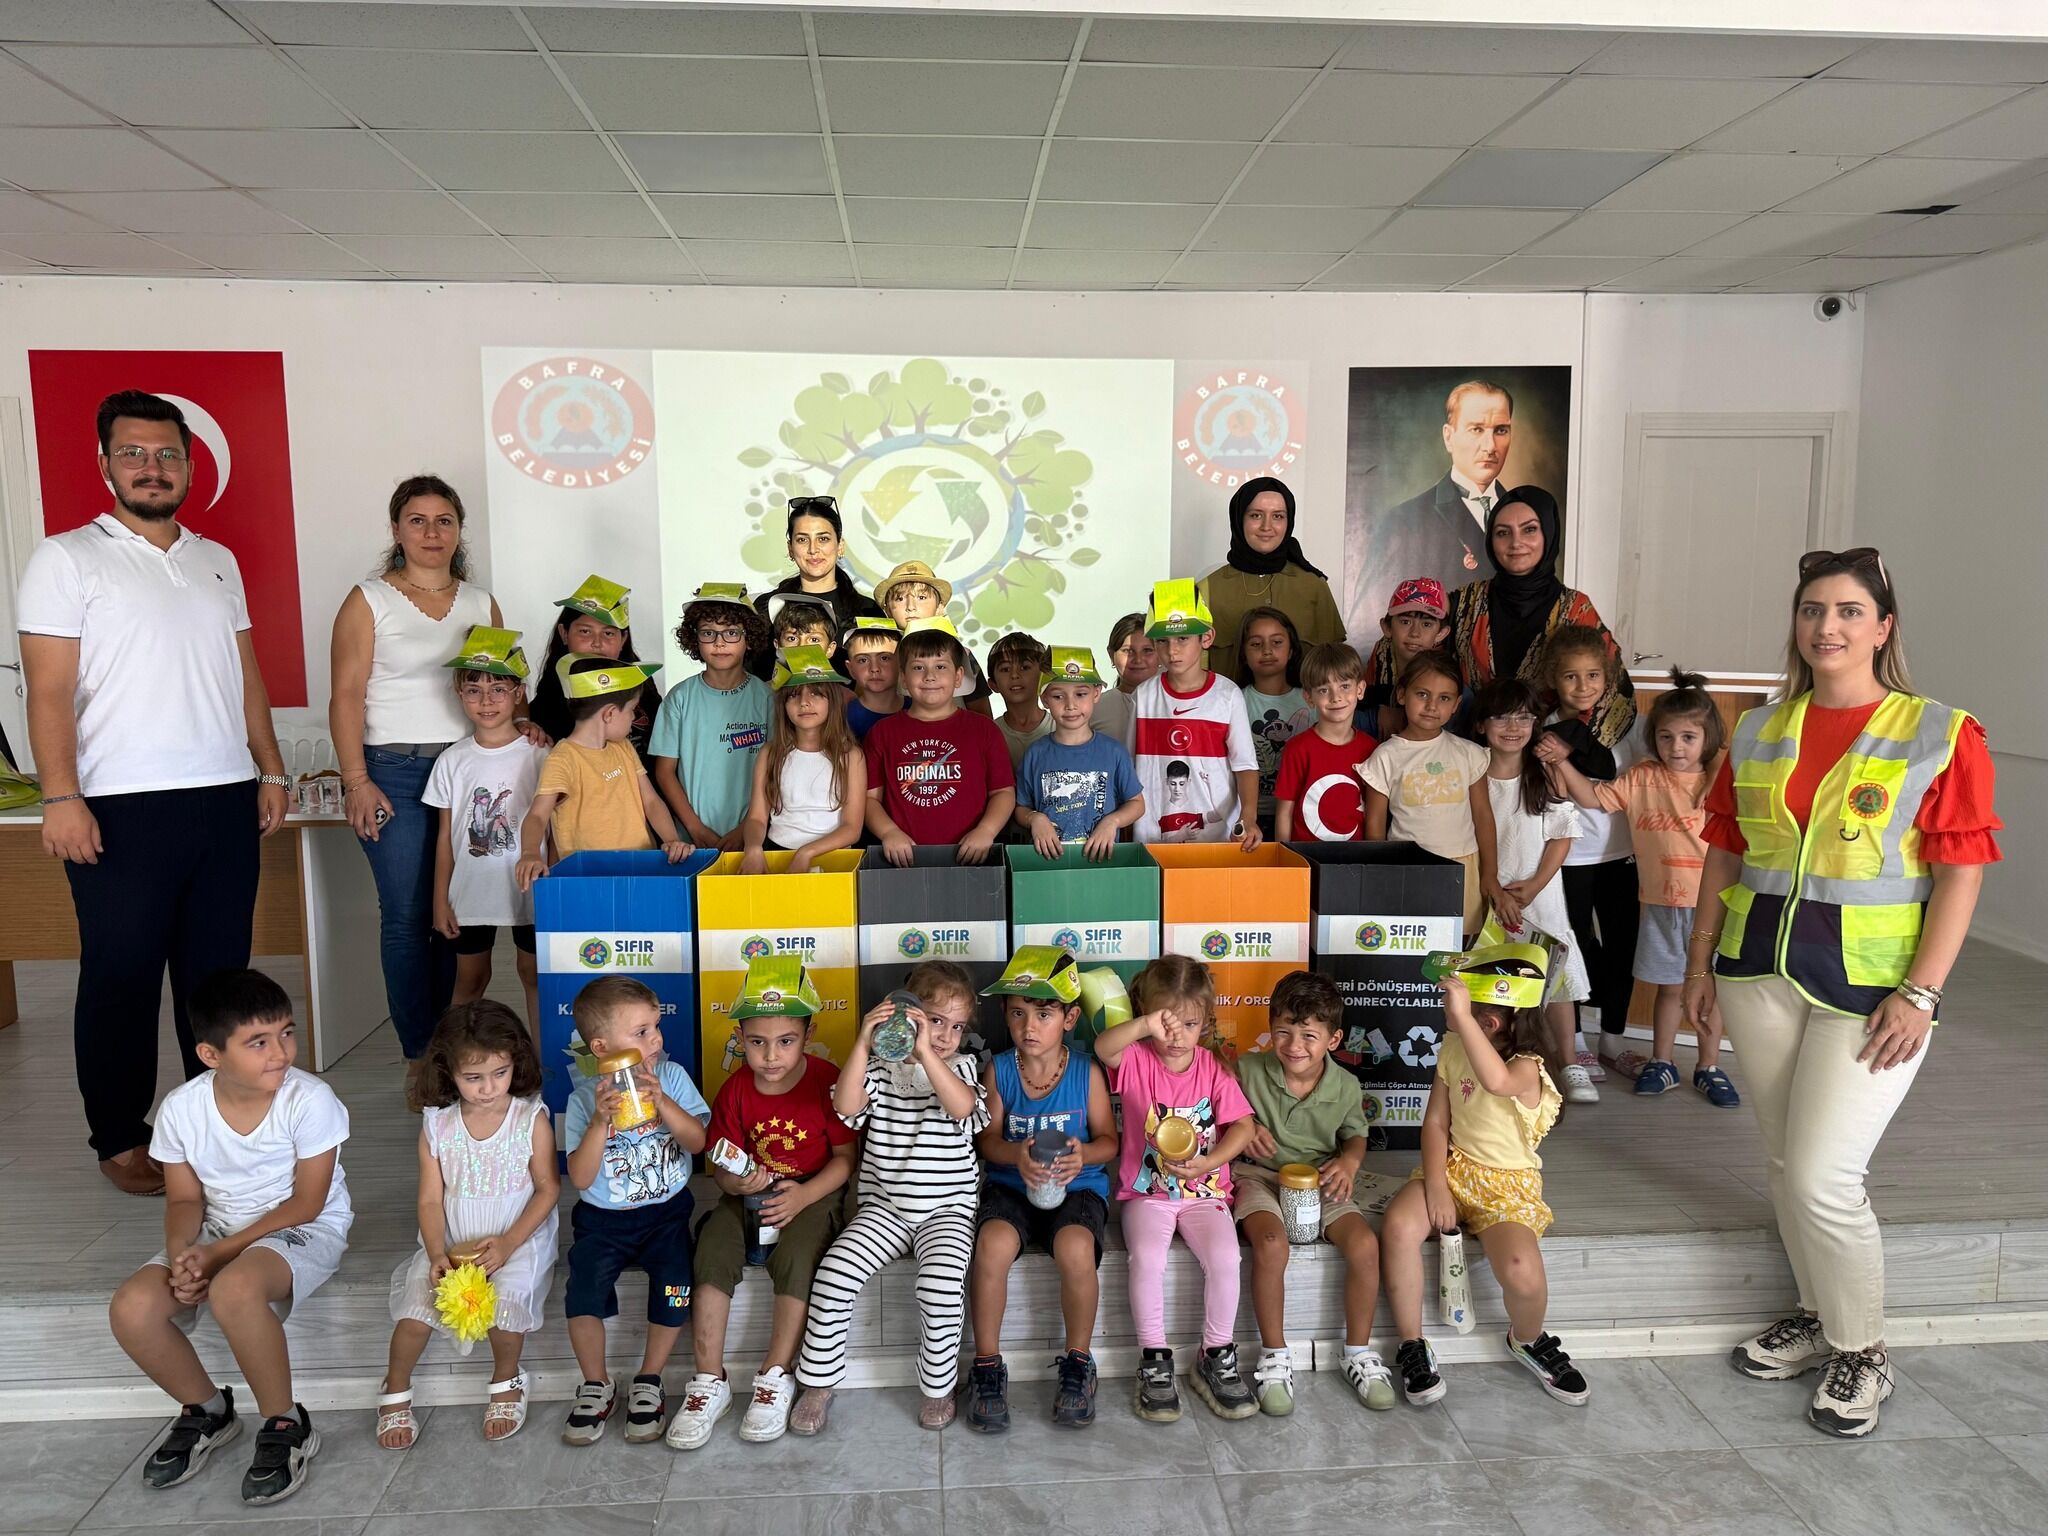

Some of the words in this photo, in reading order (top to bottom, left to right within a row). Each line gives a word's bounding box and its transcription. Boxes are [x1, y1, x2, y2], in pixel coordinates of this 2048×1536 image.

[518, 361, 625, 391] BAFRA
[1196, 372, 1285, 399] BAFRA
[498, 432, 651, 487] BELEDİYESİ
[726, 722, 748, 730] Action
[733, 731, 761, 746] WHAT!
[902, 741, 917, 755] NEW
[920, 739, 940, 747] YORK
[940, 741, 957, 753] CITY
[922, 750, 936, 758] NYC
[897, 764, 961, 781] ORIGINALS
[919, 785, 938, 794] 1992
[901, 786, 931, 807] VINTAGE
[932, 786, 957, 807] DENIM
[932, 929, 969, 942] SIFIR
[1085, 929, 1122, 941] SIFIR
[1390, 924, 1427, 937] SIFIR
[776, 937, 816, 949] SIFIR
[1235, 931, 1272, 944] SIFIR
[1390, 937, 1426, 950] ATIK
[615, 940, 654, 953] SIFIR
[933, 943, 969, 955] ATIK
[1086, 942, 1122, 954] ATIK
[1235, 944, 1272, 957] ATIK
[616, 953, 654, 966] ATIK
[1244, 996, 1271, 1006] ORG
[1342, 997, 1446, 1008] ONRECYCLABLE
[1388, 1080, 1407, 1089] Çöpe
[1408, 1082, 1433, 1090] Atmay
[1385, 1096, 1422, 1108] SIFIR
[1385, 1109, 1422, 1121] ATIK
